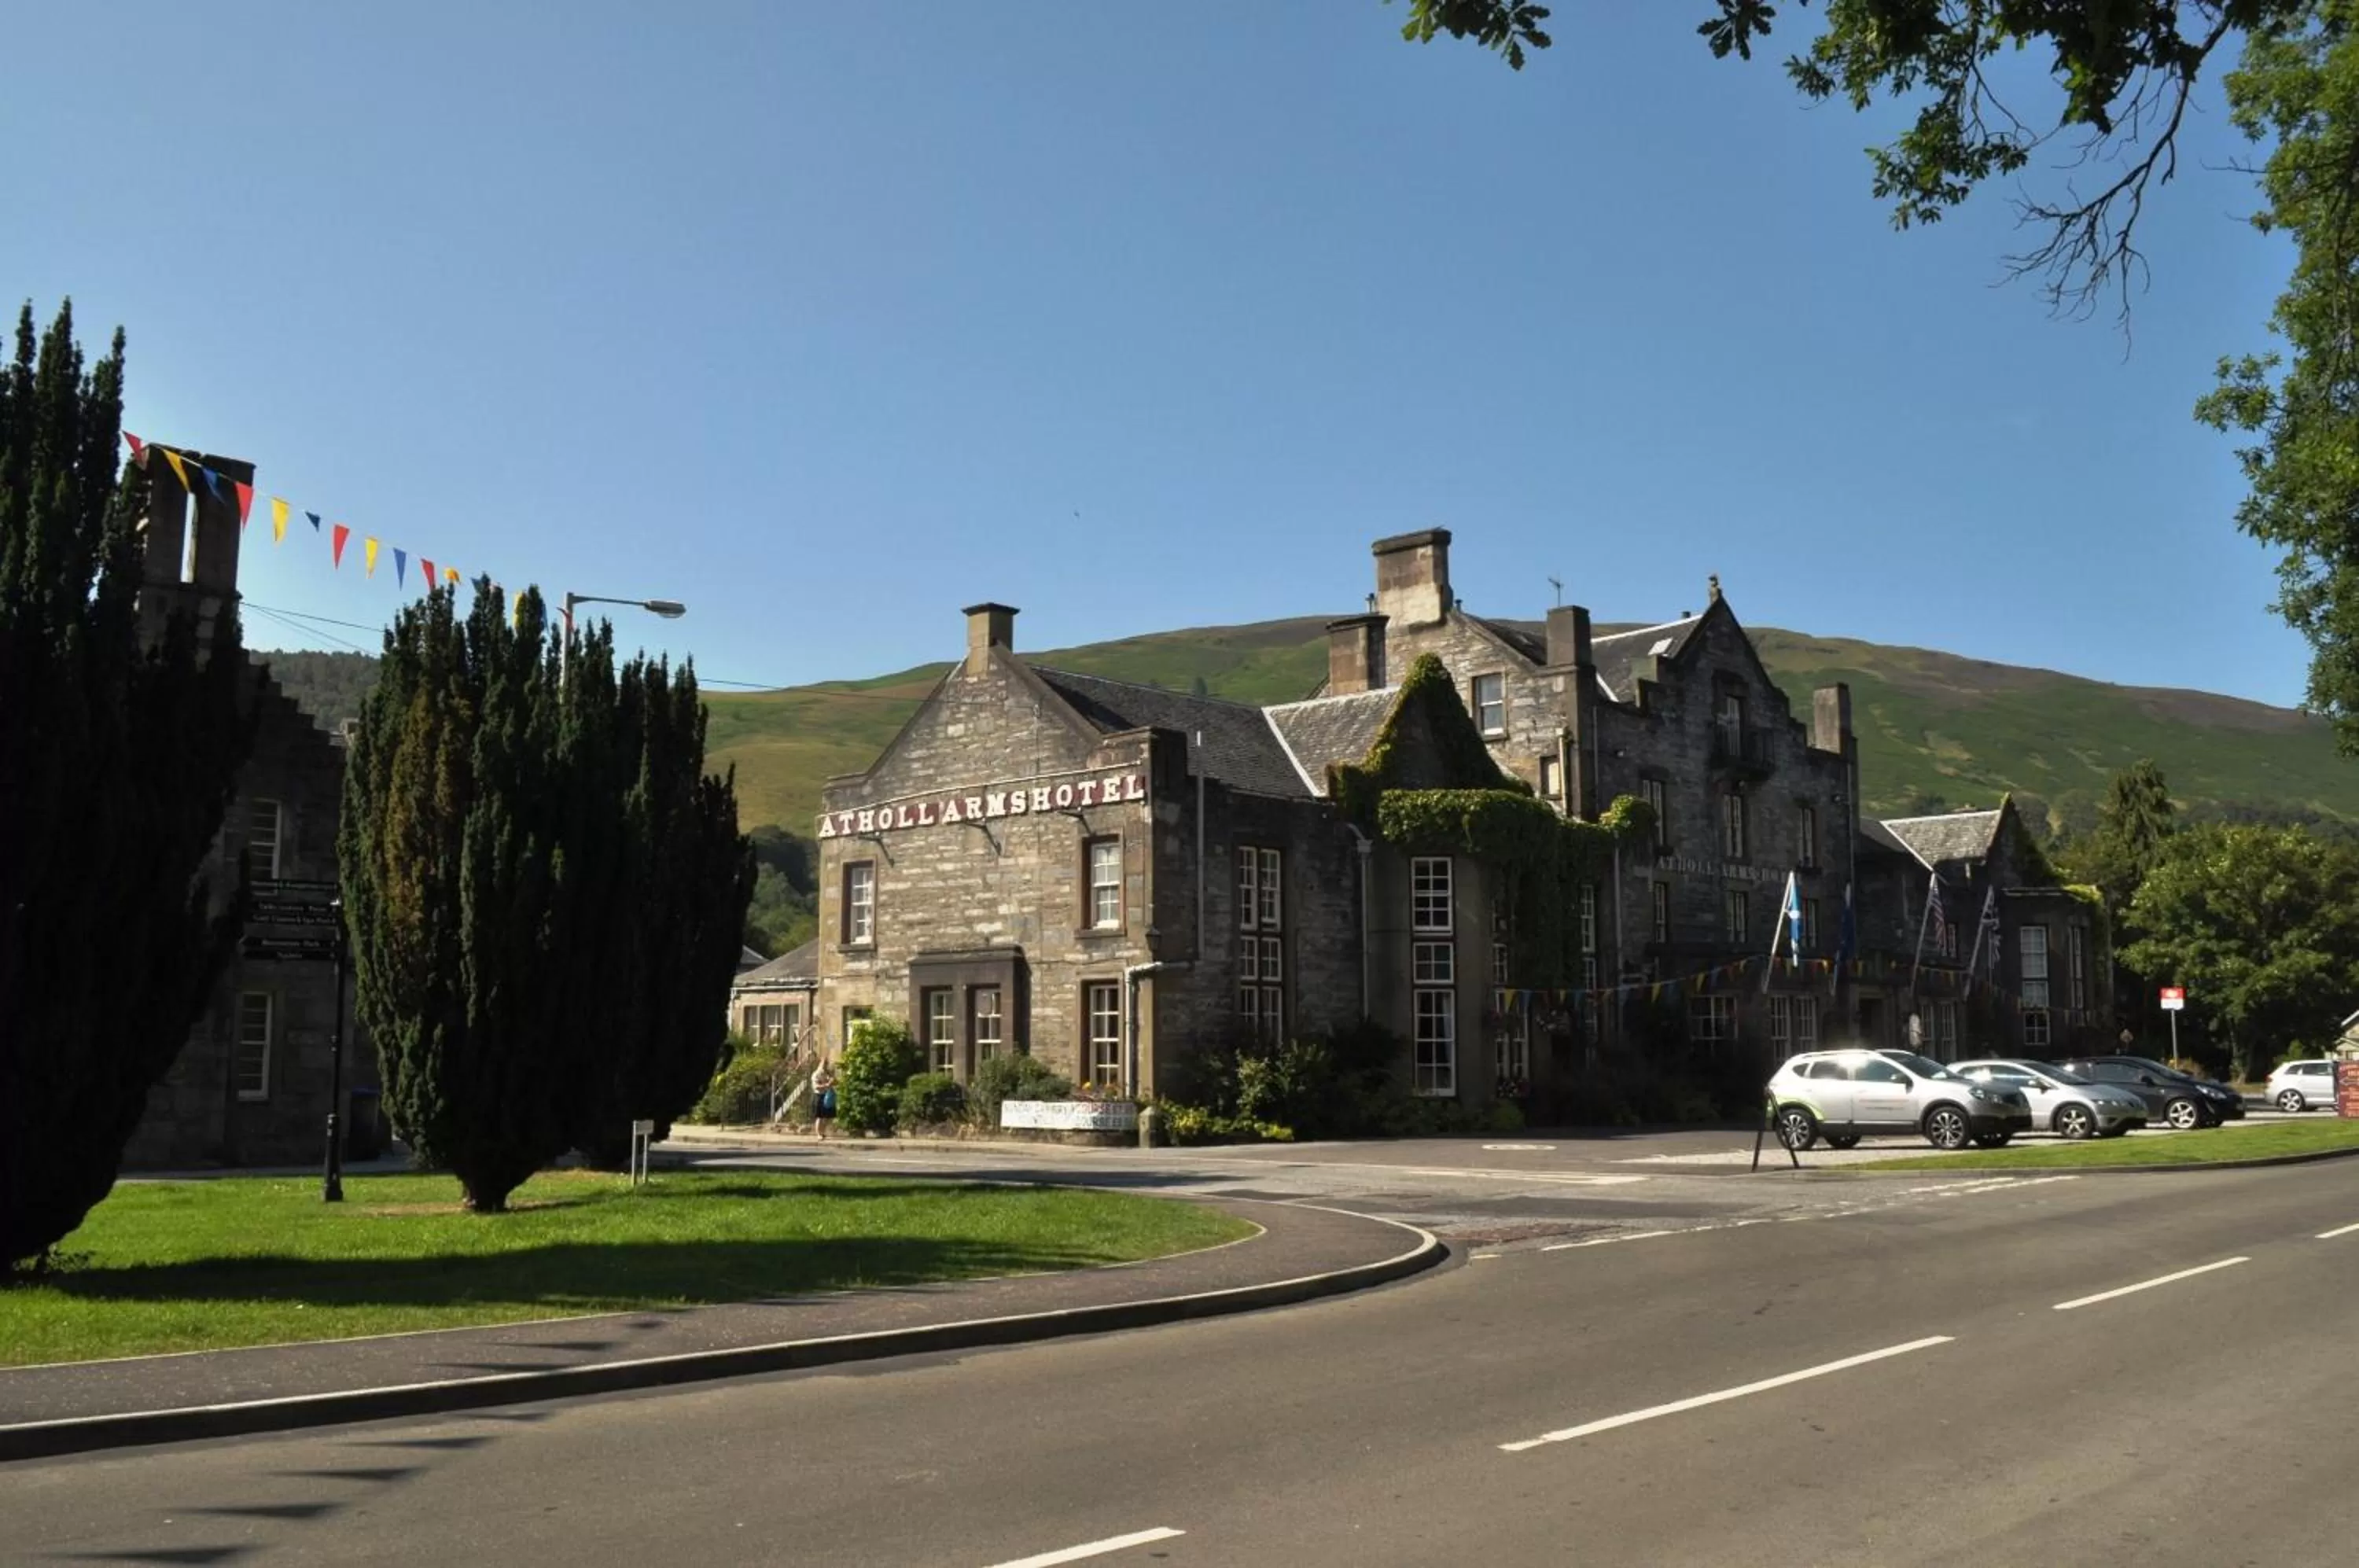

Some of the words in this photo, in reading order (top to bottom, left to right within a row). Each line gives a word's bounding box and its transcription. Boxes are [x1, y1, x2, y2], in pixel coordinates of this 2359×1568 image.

[819, 803, 935, 837] ATHOLL
[942, 790, 1026, 823] ARMS
[1031, 775, 1145, 811] HOTEL
